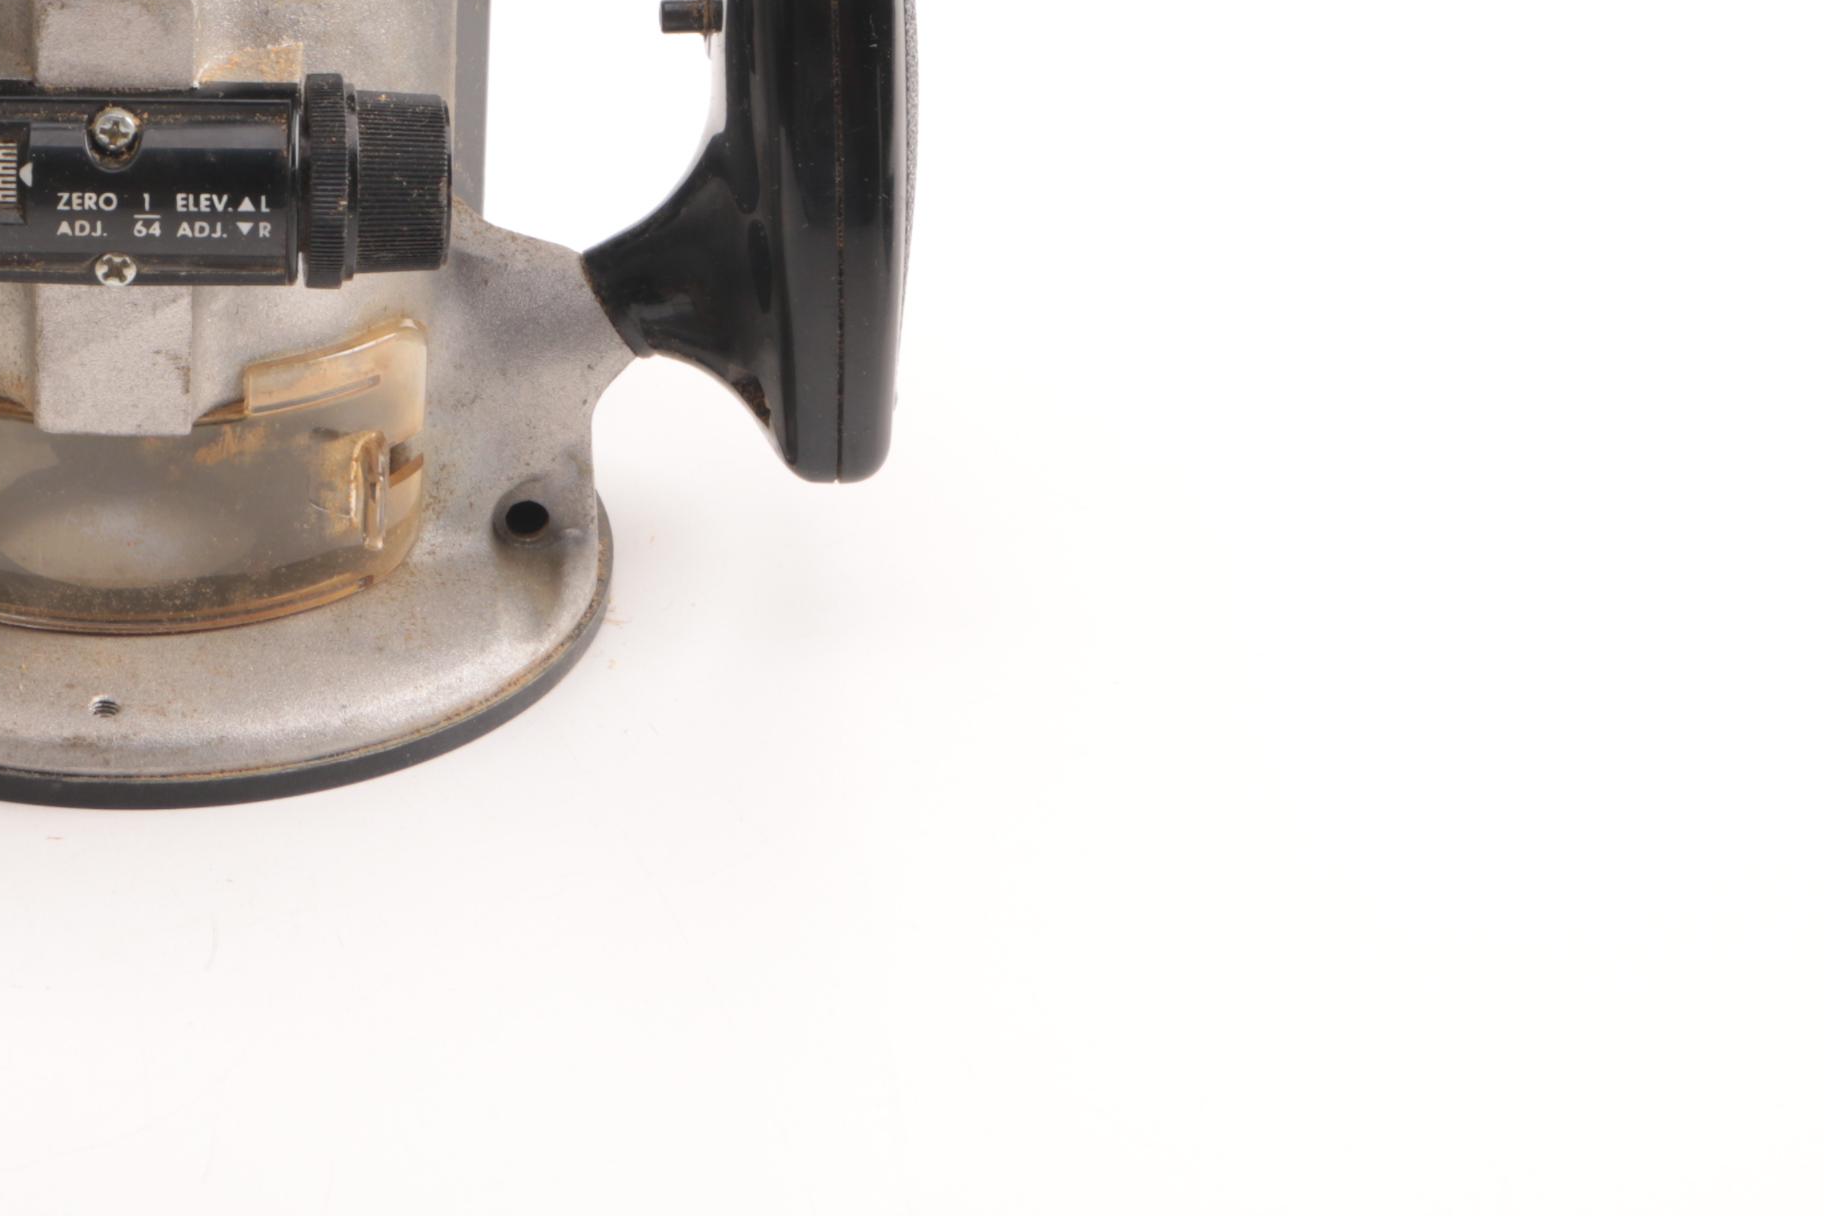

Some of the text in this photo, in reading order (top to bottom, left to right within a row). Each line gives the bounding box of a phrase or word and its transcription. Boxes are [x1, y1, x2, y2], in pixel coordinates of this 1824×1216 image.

[56, 193, 118, 212] ZERO
[176, 194, 233, 213] ELEV.
[260, 194, 270, 213] L
[56, 220, 271, 239] ADJ. 64 ADJ. R
